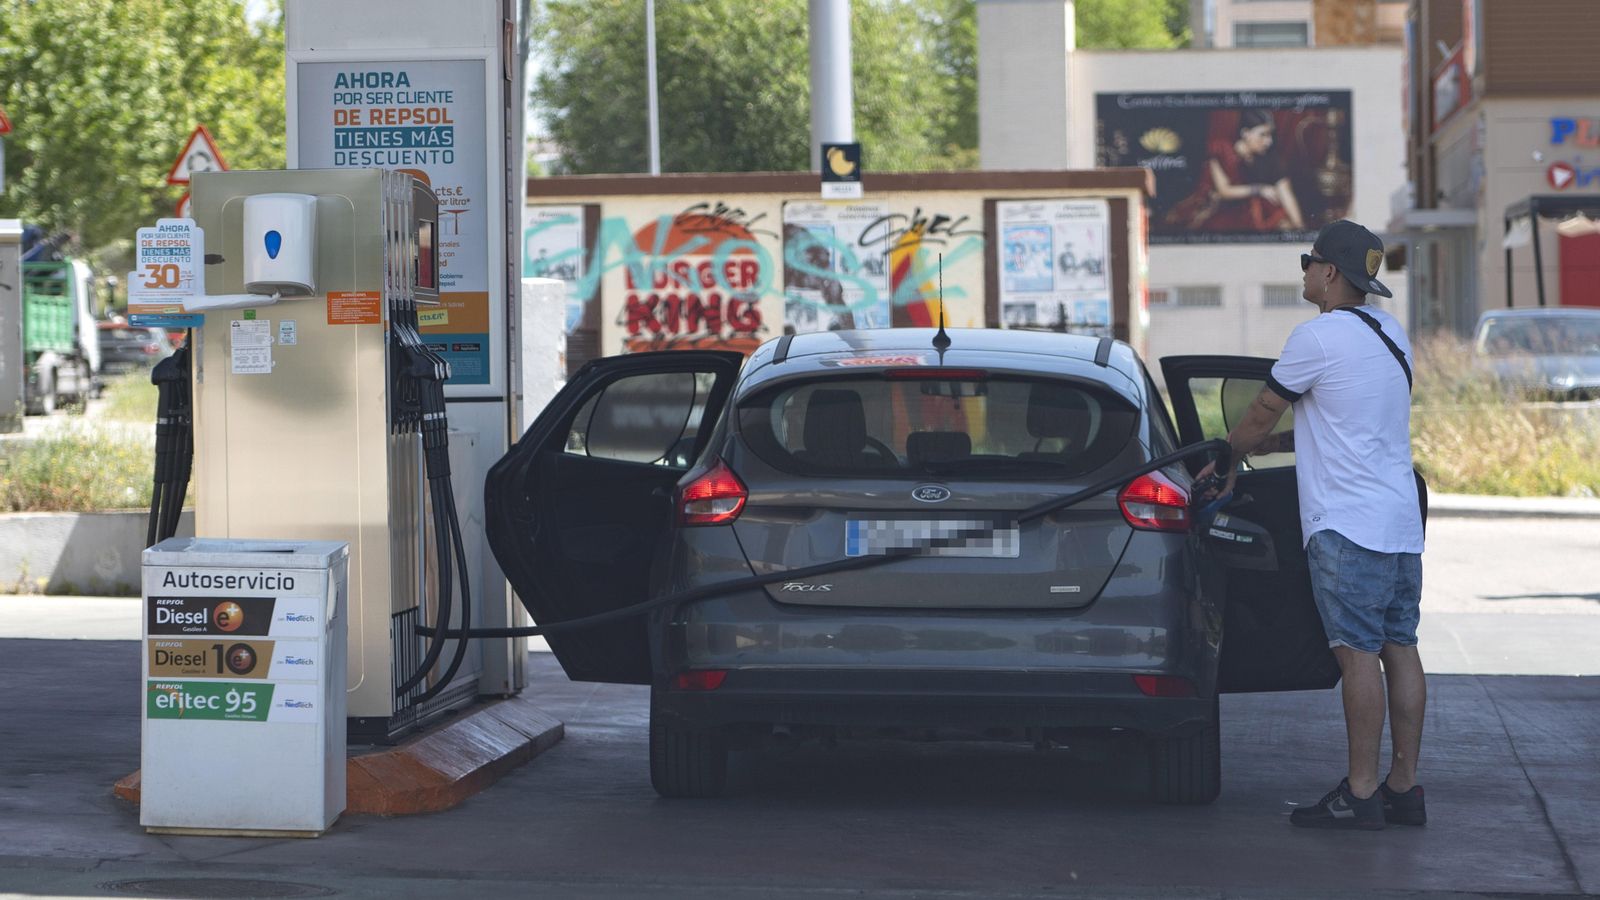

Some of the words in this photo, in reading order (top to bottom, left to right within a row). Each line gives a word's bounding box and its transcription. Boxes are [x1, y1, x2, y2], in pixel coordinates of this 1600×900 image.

[334, 72, 411, 88] AHORA
[334, 92, 362, 105] POR
[366, 92, 393, 105] SER
[397, 91, 453, 104] CLIENTE
[334, 109, 361, 126] DE
[370, 108, 453, 125] REPSOL
[336, 131, 403, 147] TIENES
[411, 127, 453, 146] MÁS
[334, 150, 454, 166] DESCUENTO
[159, 225, 190, 233] AHORA
[142, 248, 171, 256] TIENES
[138, 264, 180, 288] -30
[626, 292, 763, 335] KING
[920, 488, 942, 499] Ford
[162, 571, 295, 590] Autoservicio
[156, 607, 208, 624] Diesel
[155, 650, 206, 666] Diesel
[155, 692, 220, 710] efitec
[225, 688, 257, 713] 95
